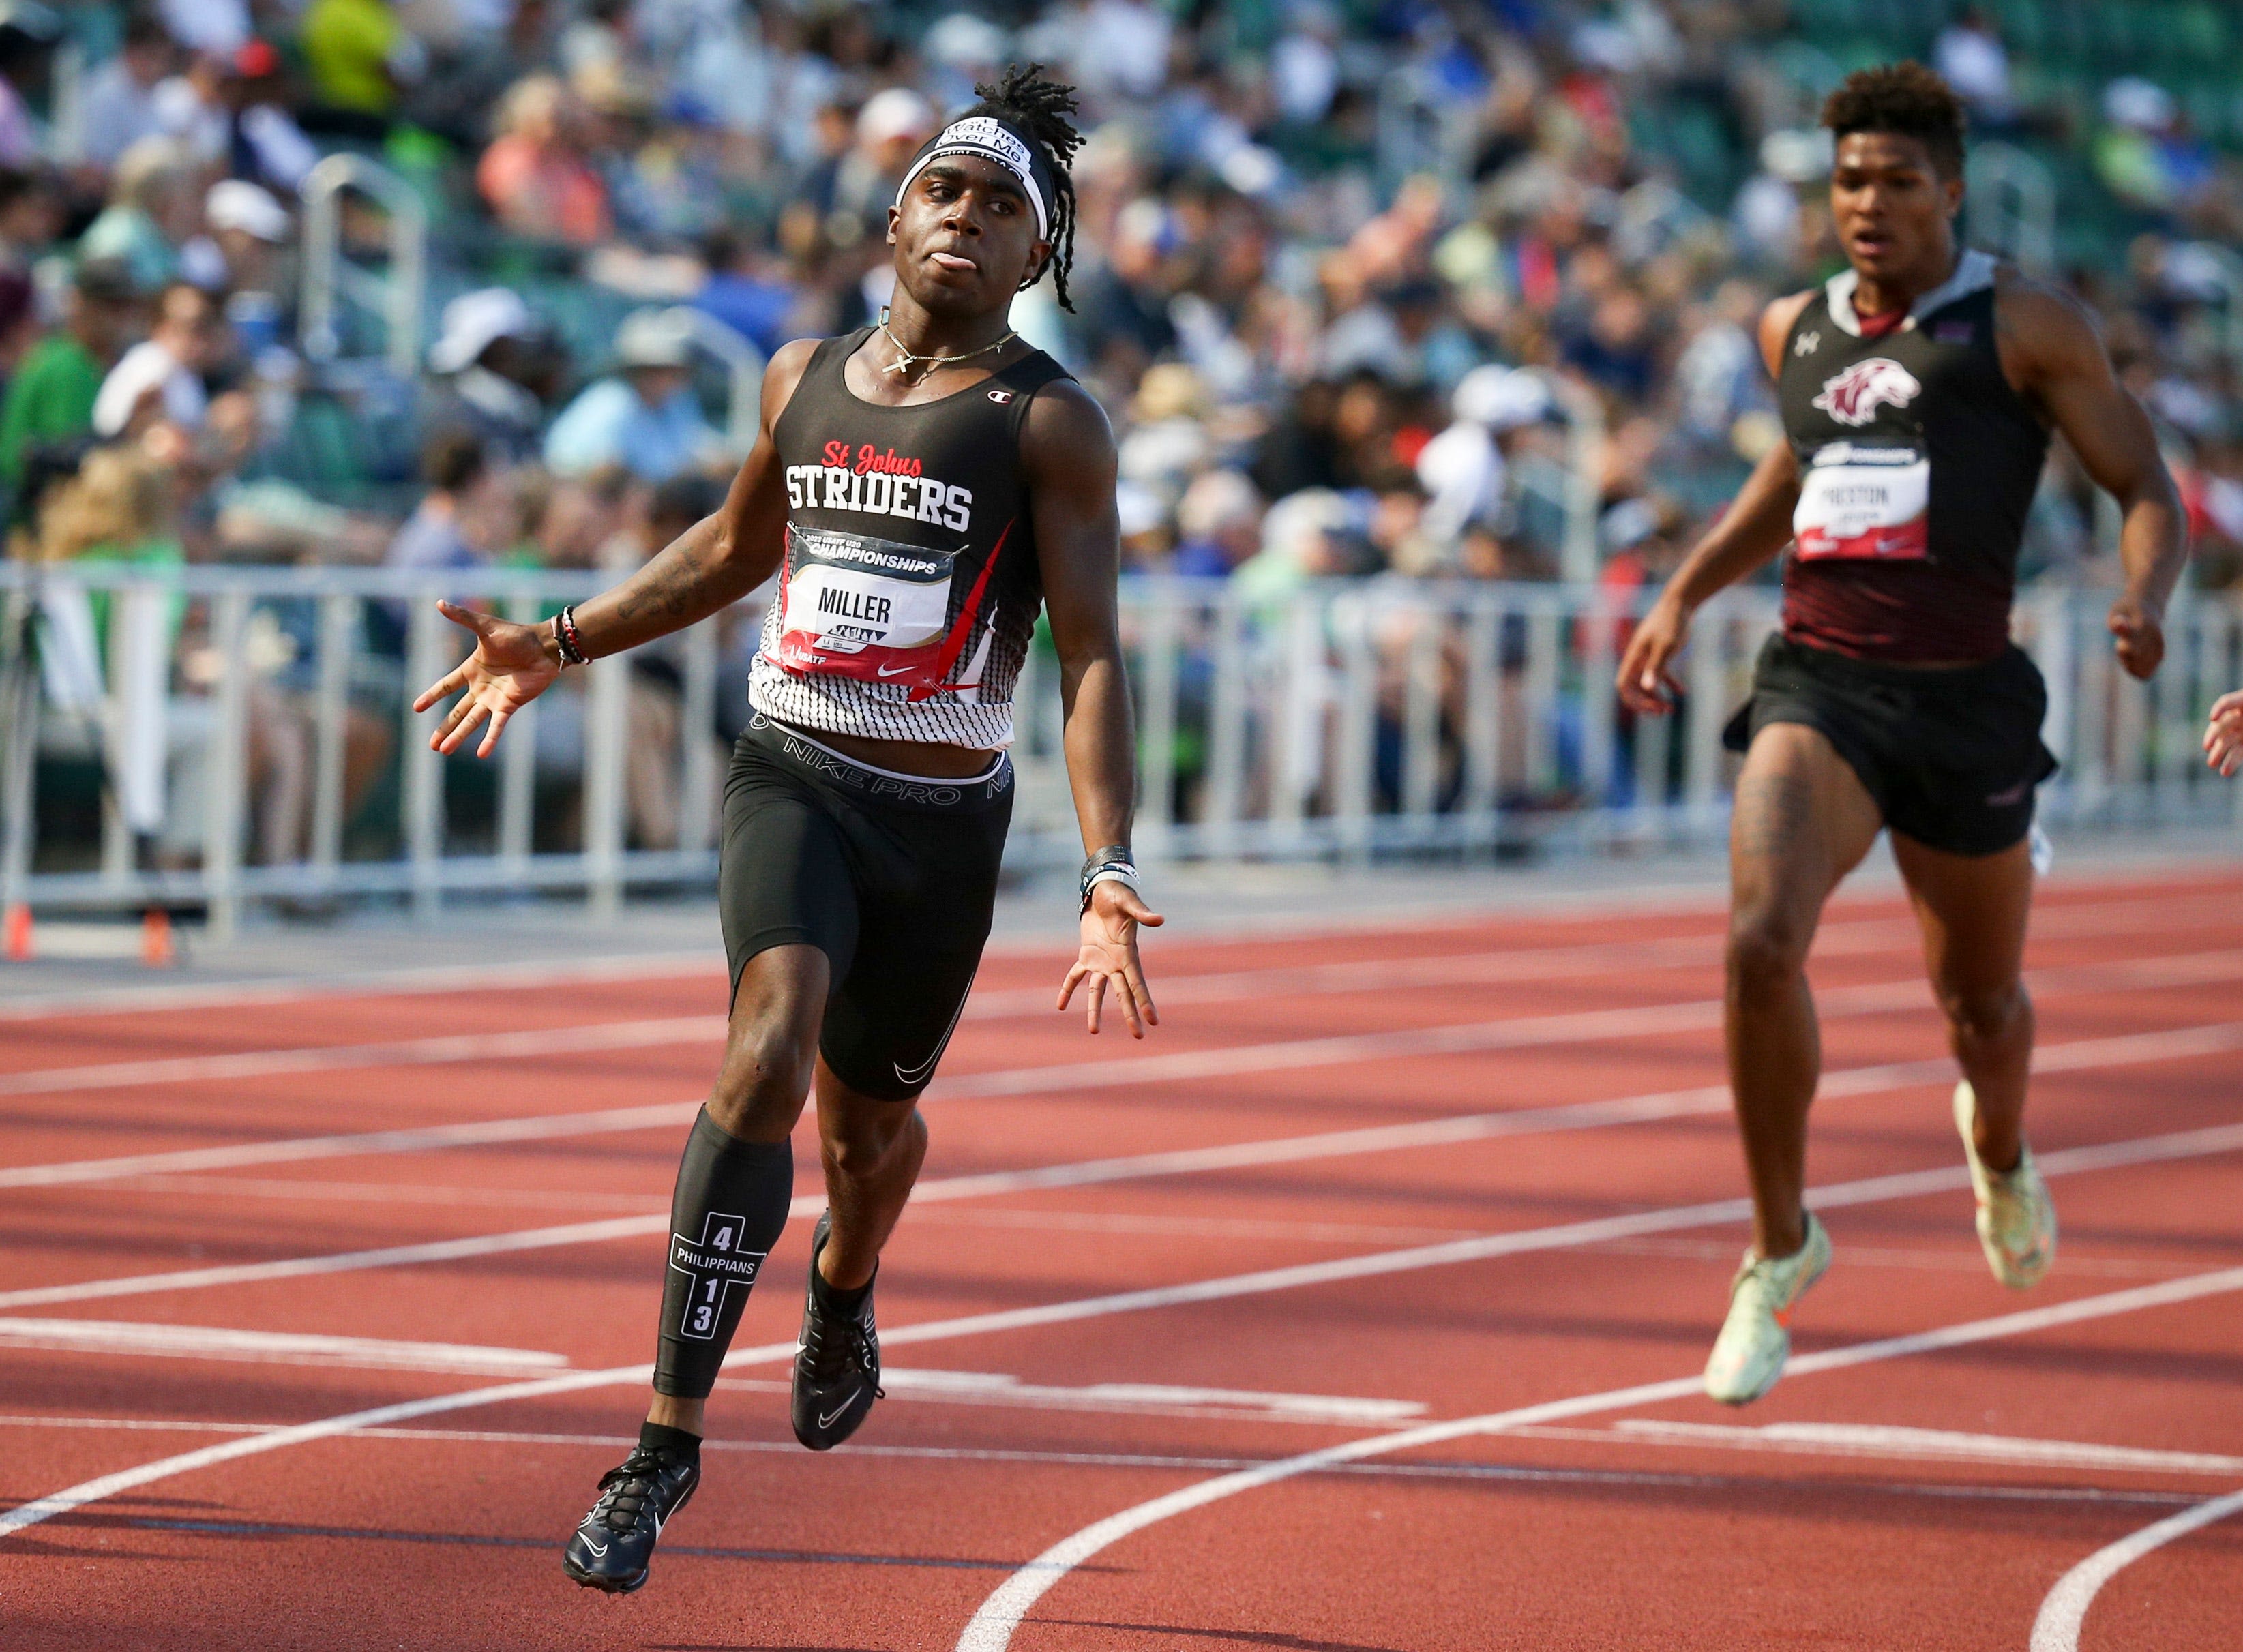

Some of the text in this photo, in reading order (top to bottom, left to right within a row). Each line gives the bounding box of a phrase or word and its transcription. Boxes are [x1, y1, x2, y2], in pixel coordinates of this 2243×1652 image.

[939, 134, 1022, 163] Over Me
[821, 440, 923, 477] St Johns
[786, 464, 973, 532] STRIDERS
[822, 536, 846, 545] USATF
[846, 539, 862, 549] U20
[809, 542, 938, 575] CHAMPIONSHIPS
[818, 587, 891, 624] MILLER
[799, 650, 827, 665] USATF
[783, 736, 961, 806] NIKE PRO
[713, 1227, 733, 1251] 4
[677, 1247, 755, 1274] PHILIPPIANS
[705, 1278, 718, 1303] 1
[694, 1306, 712, 1331] 3
